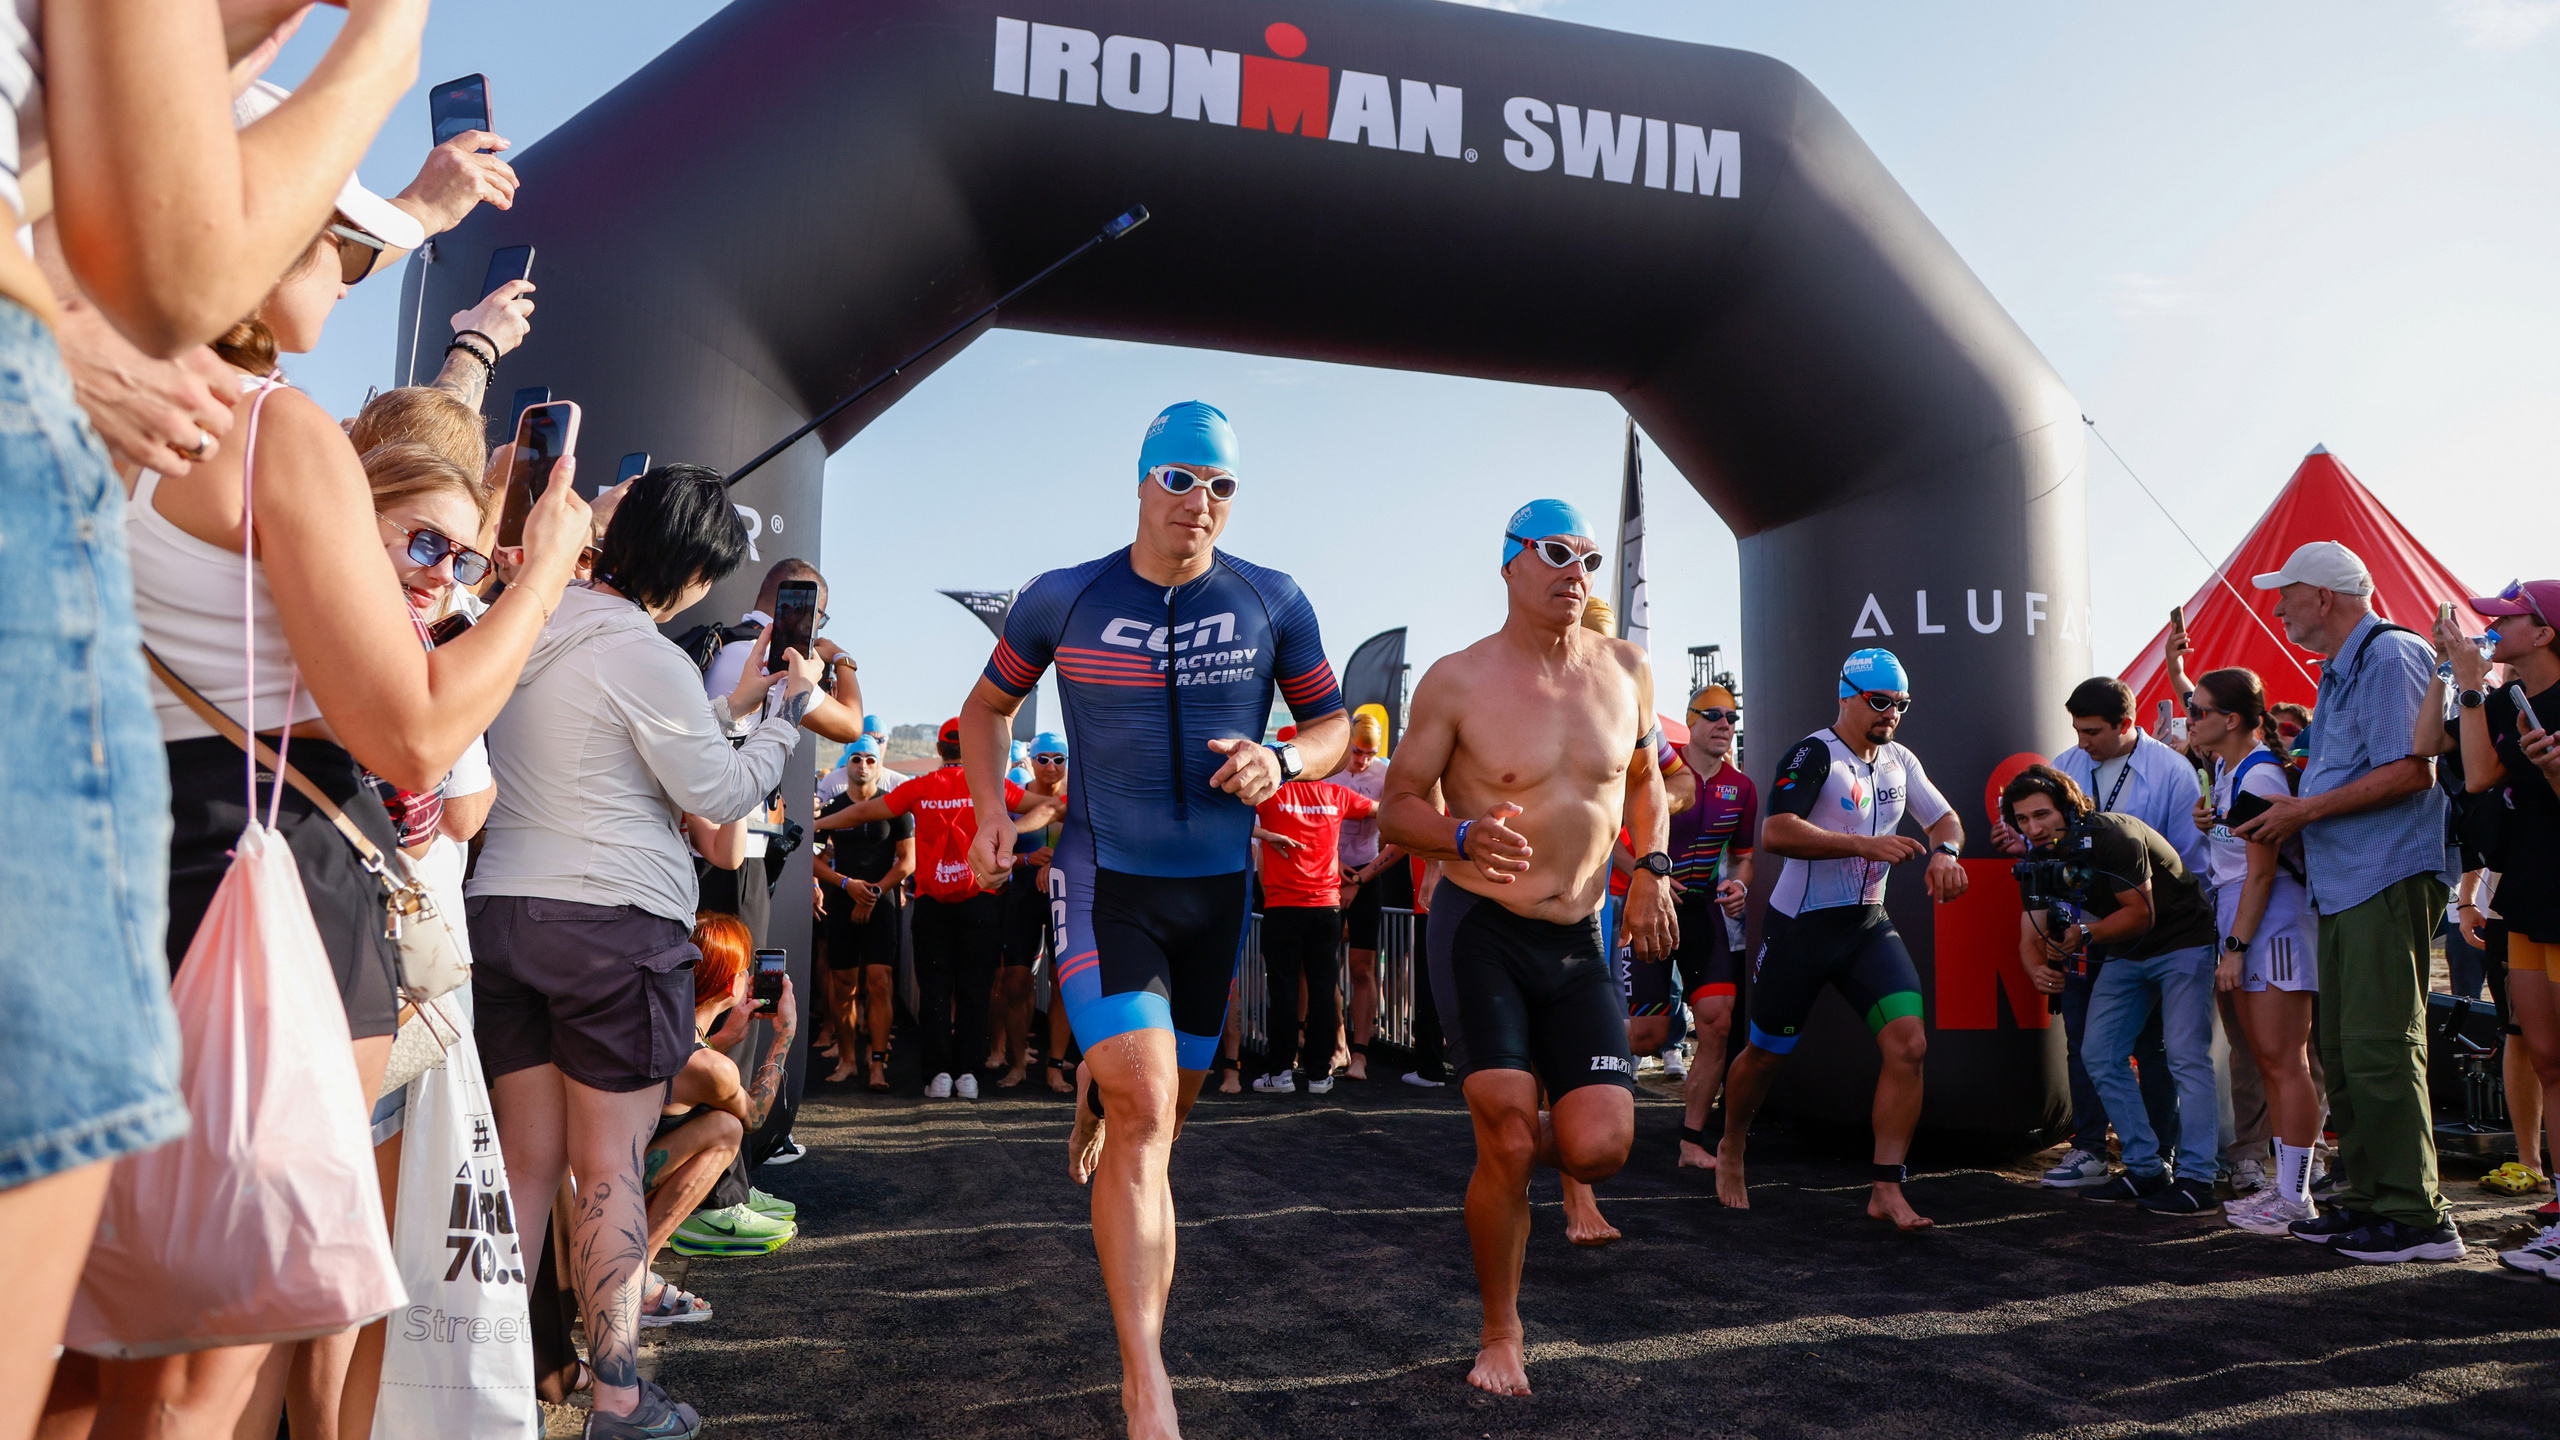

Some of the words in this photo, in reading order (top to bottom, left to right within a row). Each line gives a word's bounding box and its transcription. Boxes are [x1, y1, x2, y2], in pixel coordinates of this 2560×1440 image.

[1503, 96, 1741, 198] SWIM
[973, 604, 999, 614] min
[1158, 648, 1258, 671] FACTORY
[1176, 667, 1255, 686] RACING
[1278, 803, 1338, 815] VOLUNTEER
[403, 1305, 531, 1344] Street
